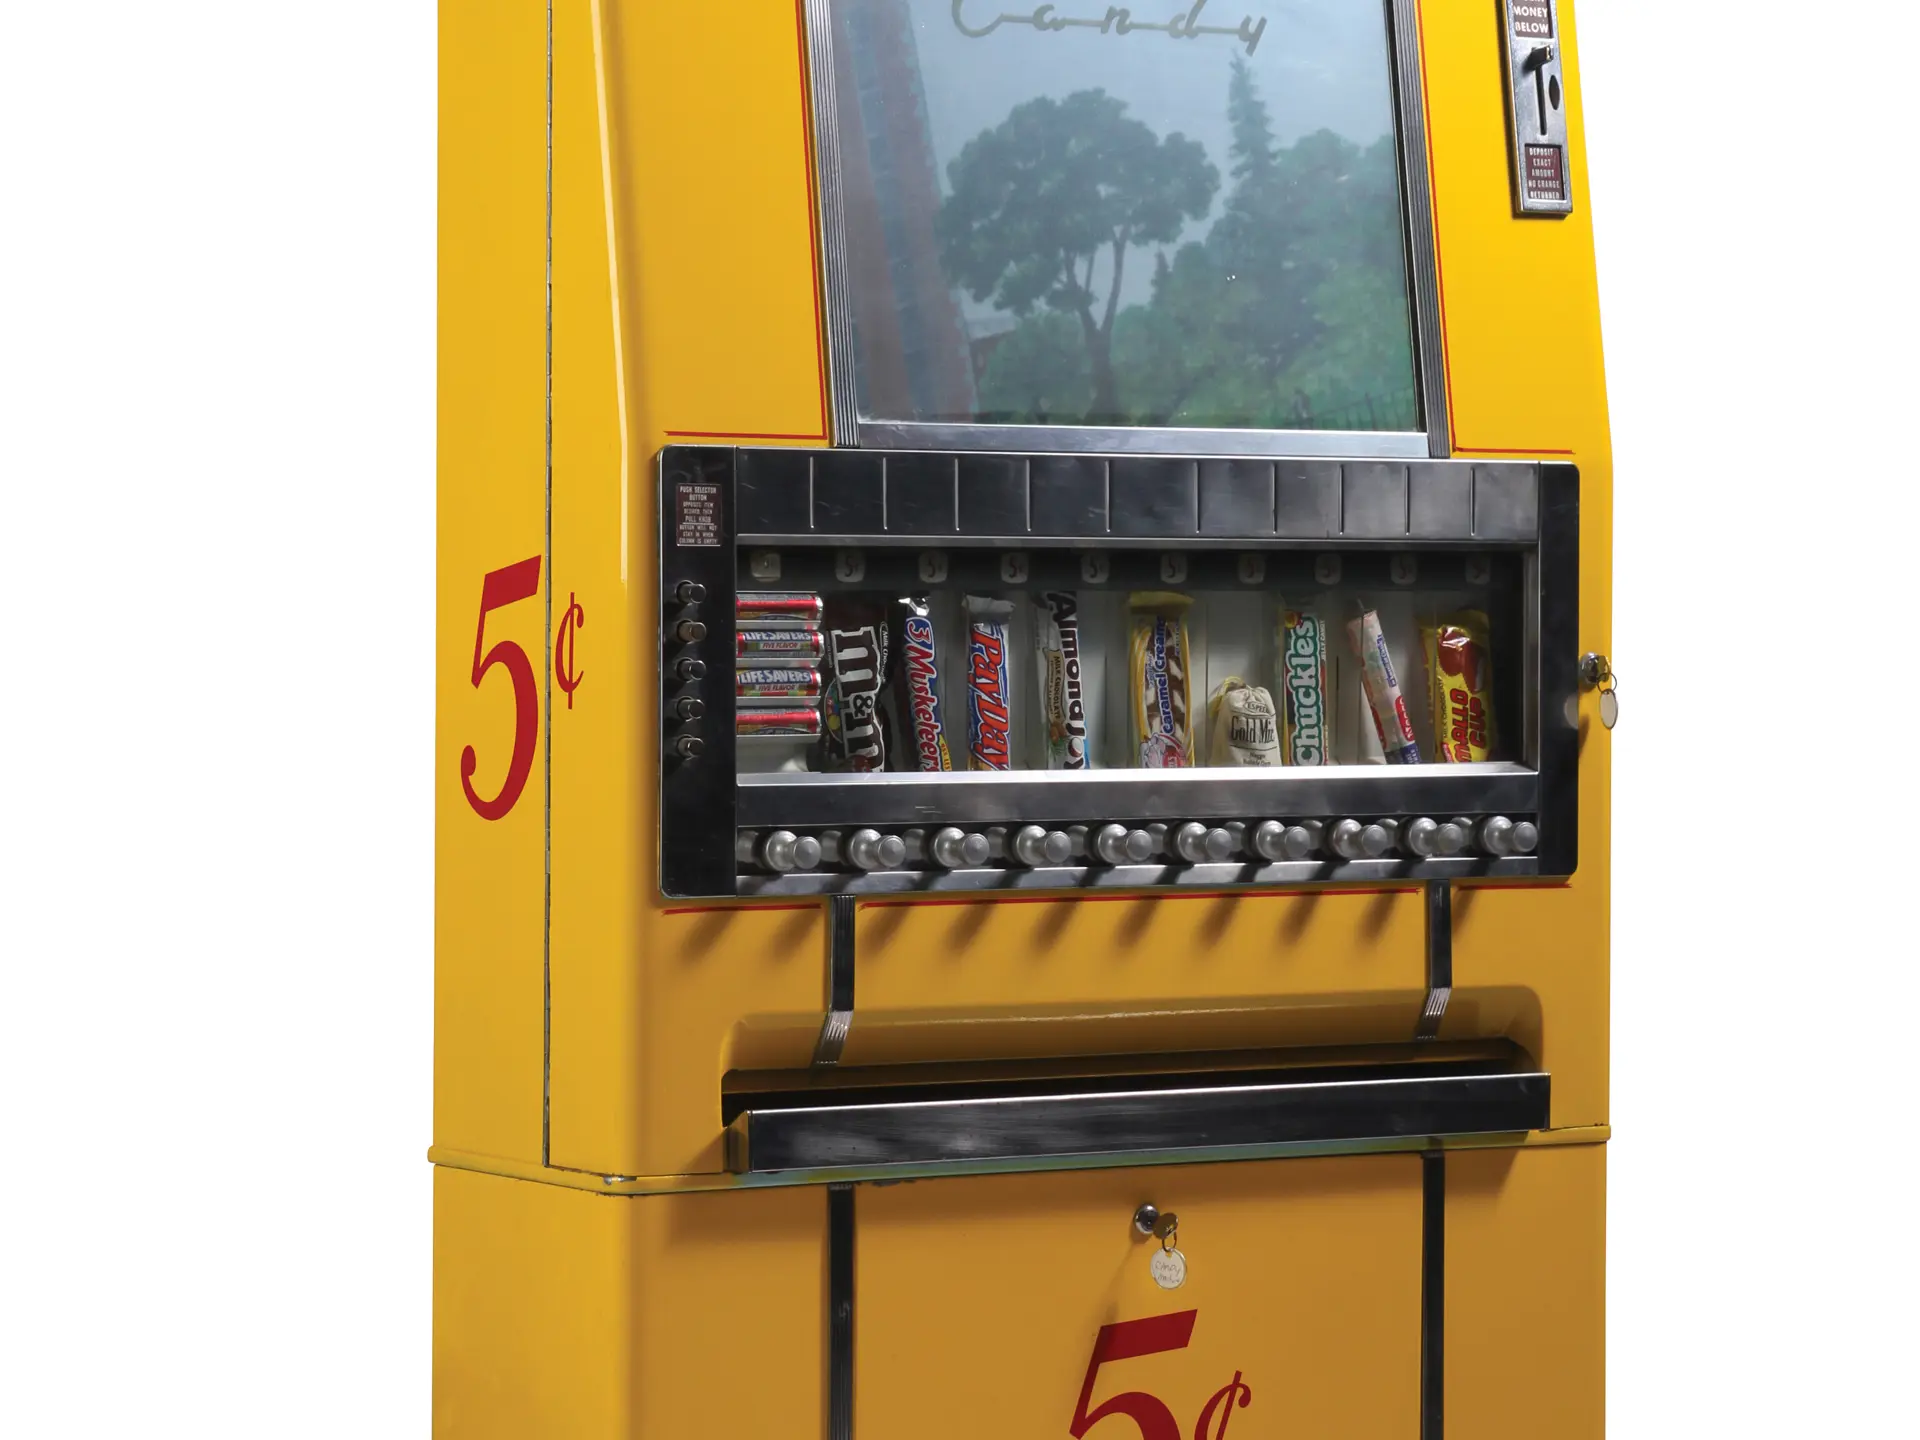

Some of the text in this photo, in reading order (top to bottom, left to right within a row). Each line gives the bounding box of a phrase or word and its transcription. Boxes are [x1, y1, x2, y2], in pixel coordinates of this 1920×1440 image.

[1513, 6, 1548, 18] MONEY
[1514, 21, 1549, 34] BELOW
[1529, 147, 1554, 156] DEPOSIT
[1532, 158, 1551, 167] EXACT
[1531, 168, 1555, 178] AMOUNT
[1528, 179, 1560, 189] NO CHANGE
[1529, 190, 1560, 199] RETURNED
[679, 485, 717, 494] PUSH SELECTOR
[685, 515, 697, 523] PULL
[907, 618, 931, 644] 3
[460, 554, 584, 821] 5¢
[1053, 656, 1062, 720] MILK CHOCOLATE
[1289, 613, 1322, 765] Chuckles
[970, 628, 1009, 771] PayDay
[1231, 715, 1256, 743] Gold
[1468, 697, 1486, 750] CUP
[1069, 1308, 1252, 1440] 5¢
